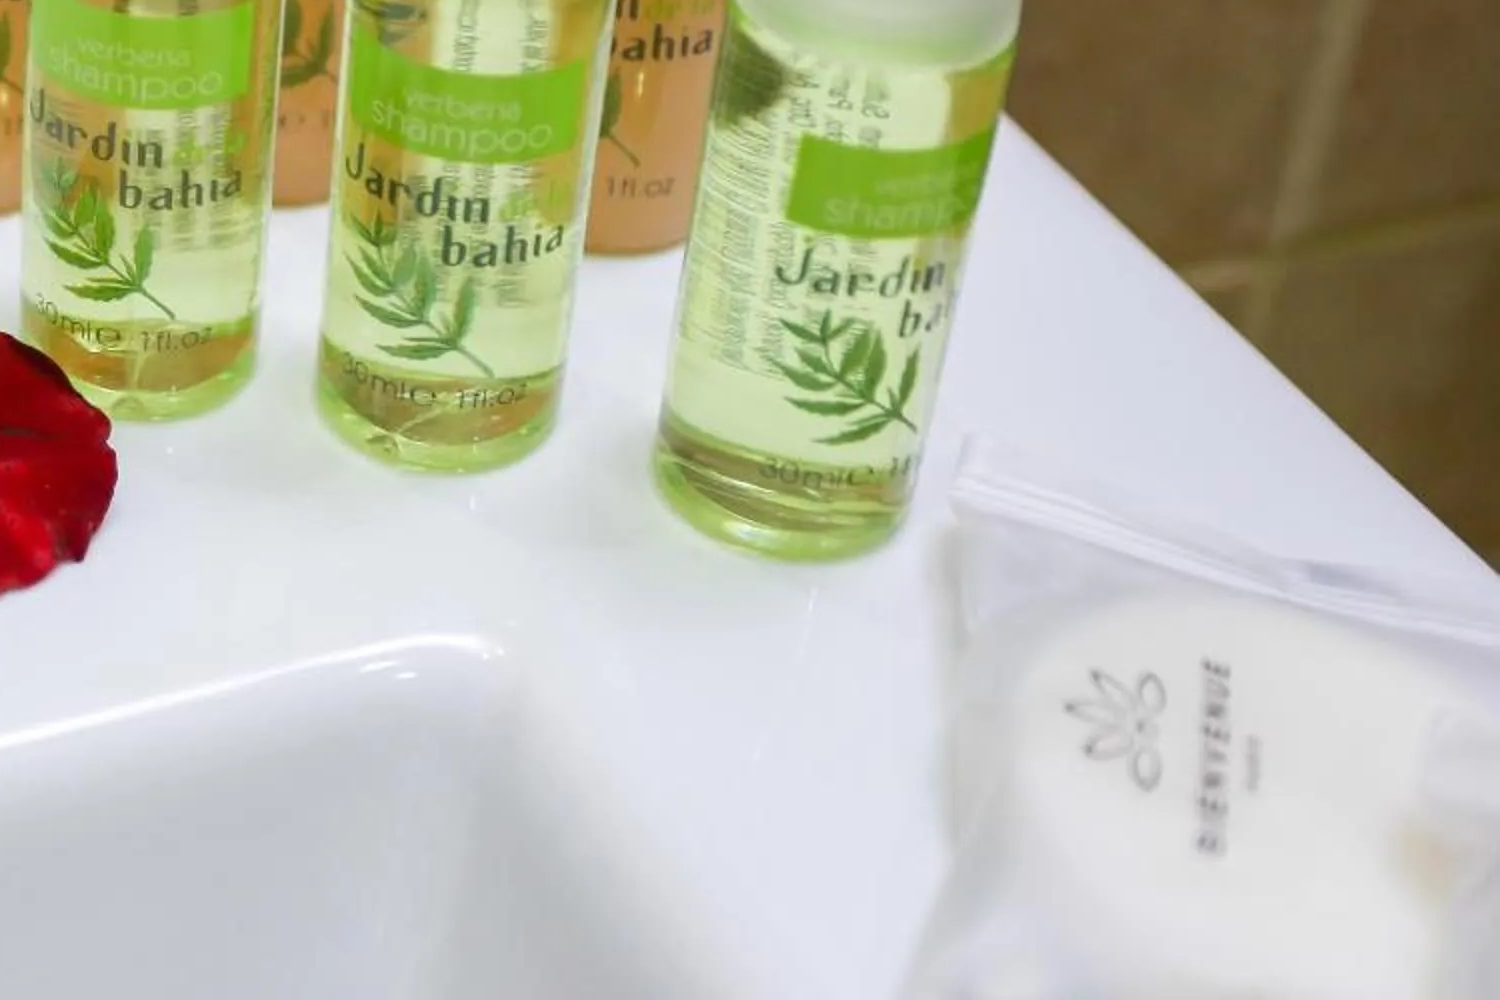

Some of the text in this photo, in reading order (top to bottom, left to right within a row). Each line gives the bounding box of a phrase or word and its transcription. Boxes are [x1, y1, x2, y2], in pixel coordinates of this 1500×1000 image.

[48, 42, 223, 104] shampoo
[29, 87, 164, 169] Jardin
[371, 99, 552, 158] shampoo
[119, 169, 242, 211] bahia
[345, 142, 490, 224] Jardin
[441, 224, 564, 269] bahia
[776, 247, 946, 298] Jardin
